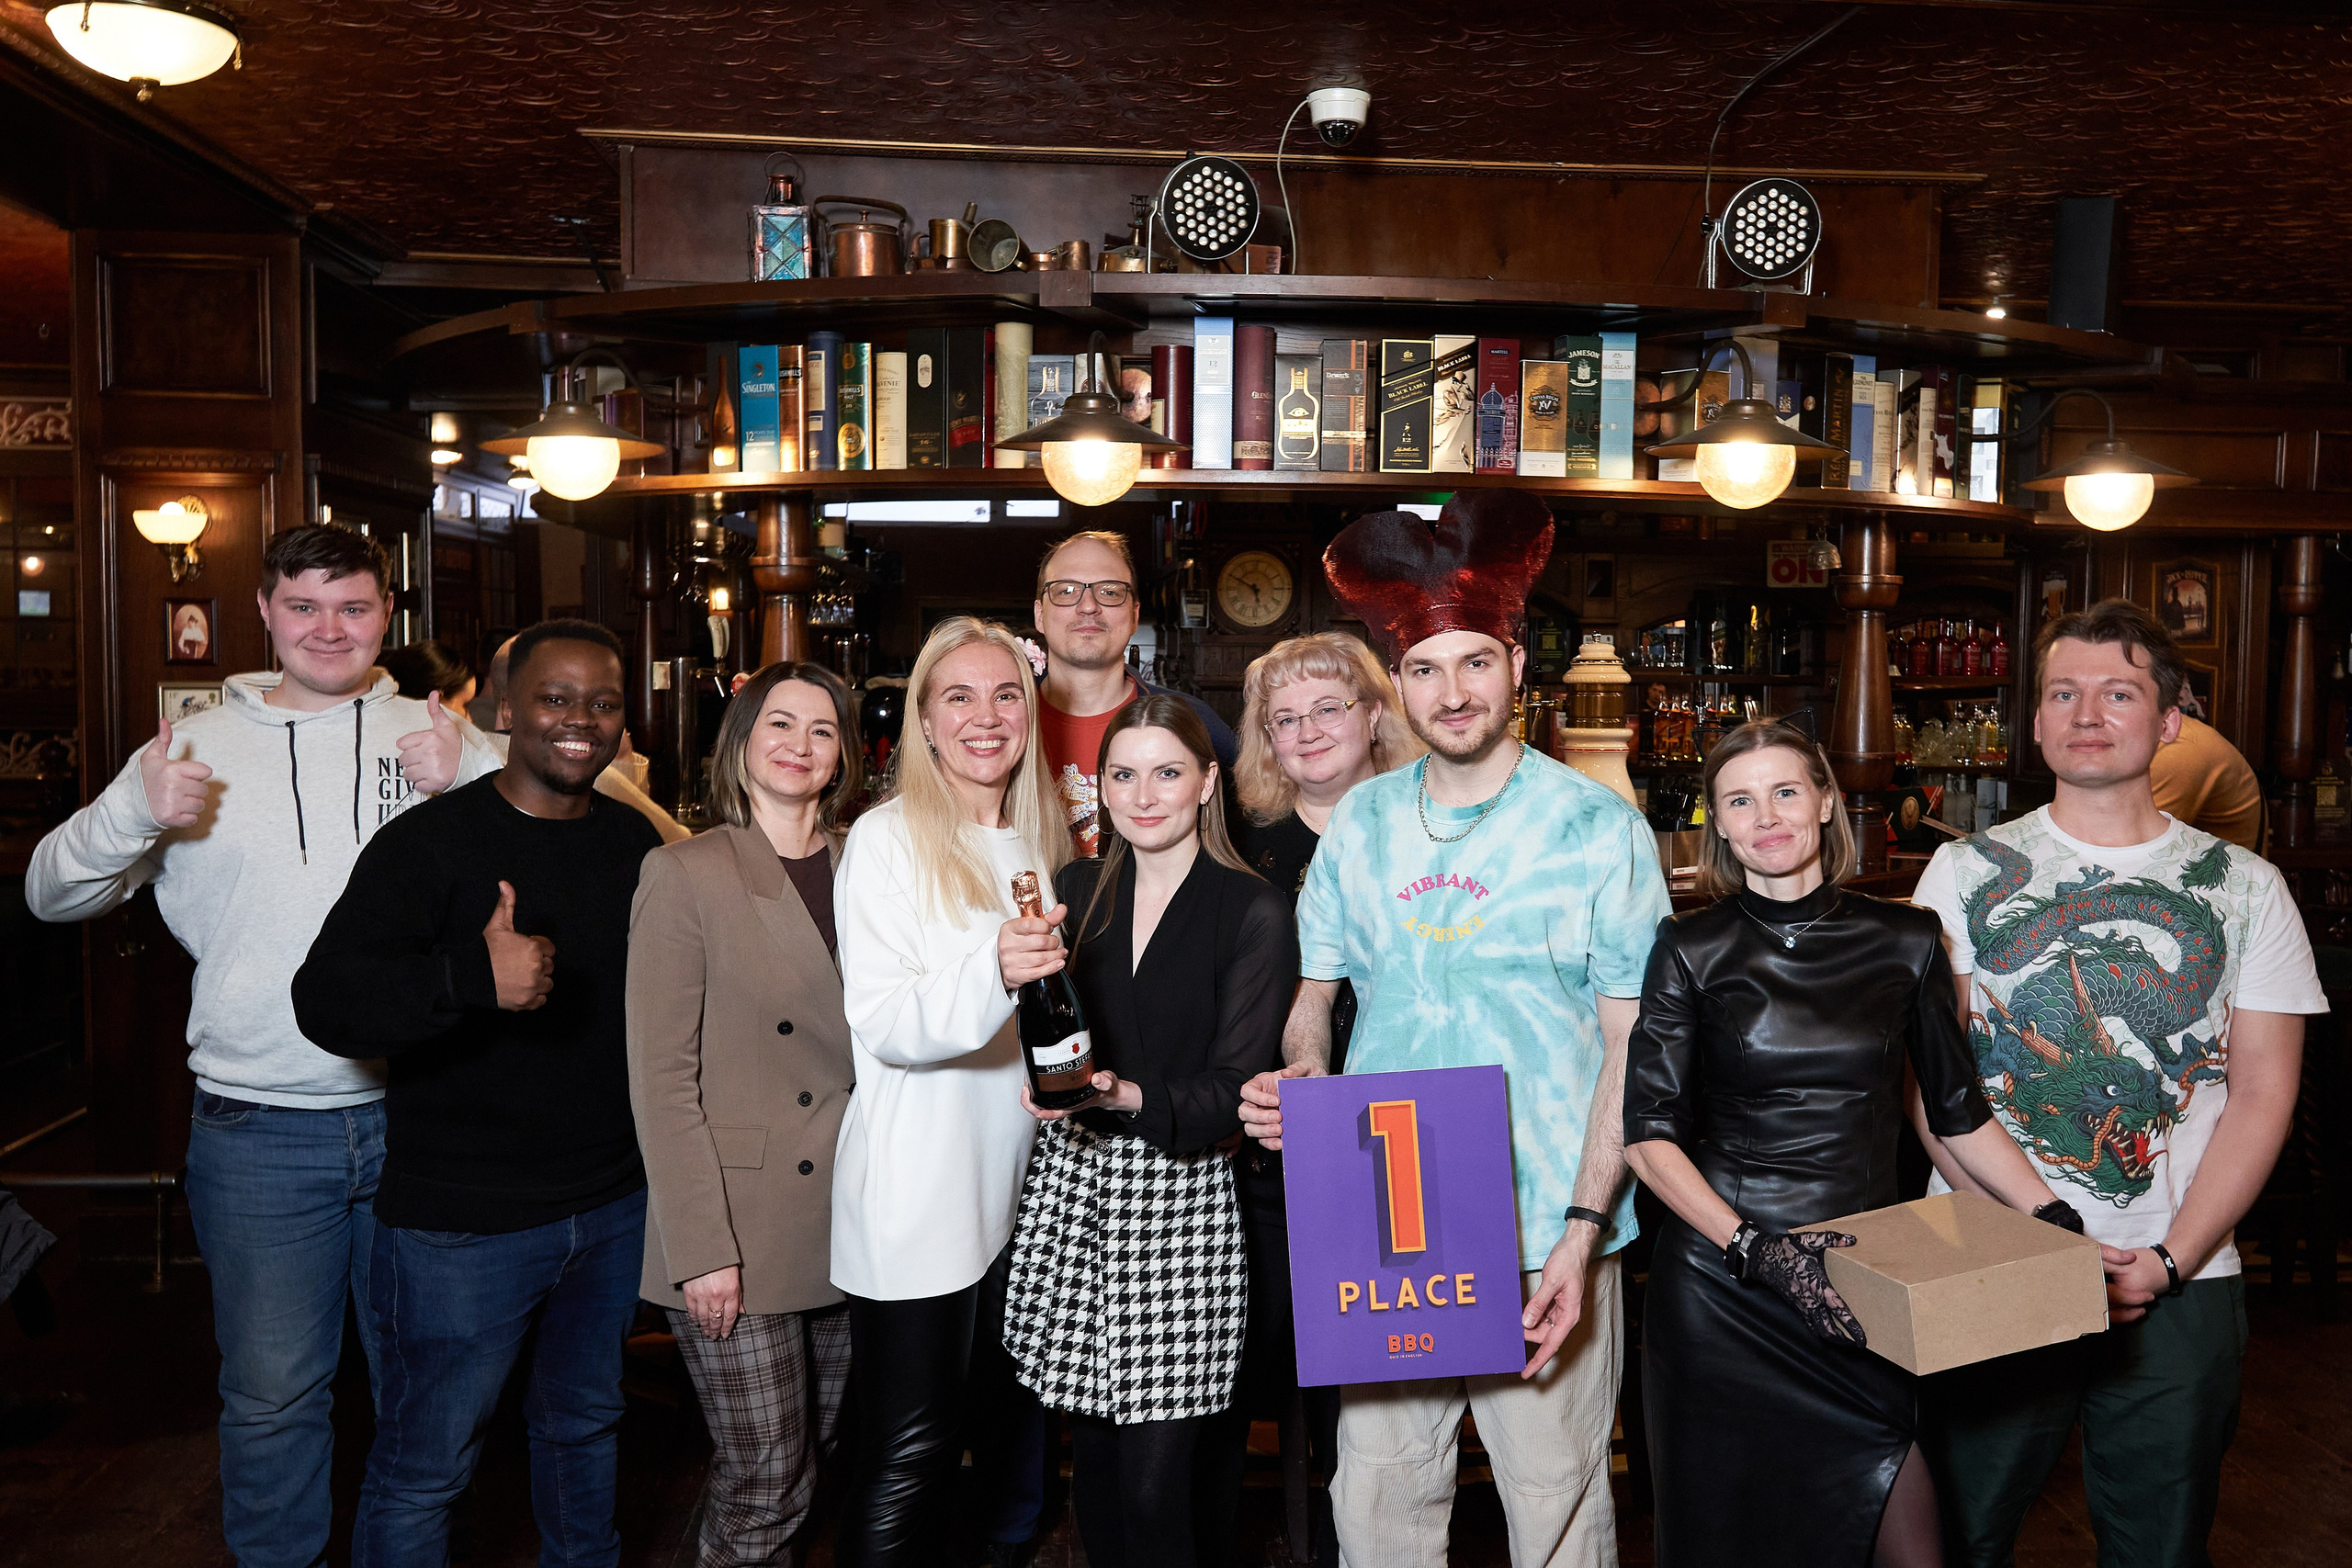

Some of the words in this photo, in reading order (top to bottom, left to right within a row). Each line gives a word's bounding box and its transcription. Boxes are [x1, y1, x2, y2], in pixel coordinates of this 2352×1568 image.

[1437, 361, 1454, 372] BLACK
[1454, 354, 1472, 365] LABEL
[1568, 349, 1600, 359] JAMESON
[742, 382, 776, 394] SINGLETON
[1387, 389, 1408, 400] BLACK
[1408, 381, 1429, 392] LABEL
[1530, 394, 1545, 402] CHIVAS
[1545, 394, 1560, 402] REGAL
[1538, 400, 1551, 411] XV
[745, 431, 754, 442] 12
[1770, 558, 1824, 584] ON
[1396, 874, 1489, 901] VIBRANT
[1400, 914, 1486, 942] ENERGY
[1046, 1062, 1073, 1073] SANTO
[1369, 1100, 1427, 1253] 1
[1338, 1273, 1476, 1313] PLACE
[1387, 1333, 1434, 1353] BBQ
